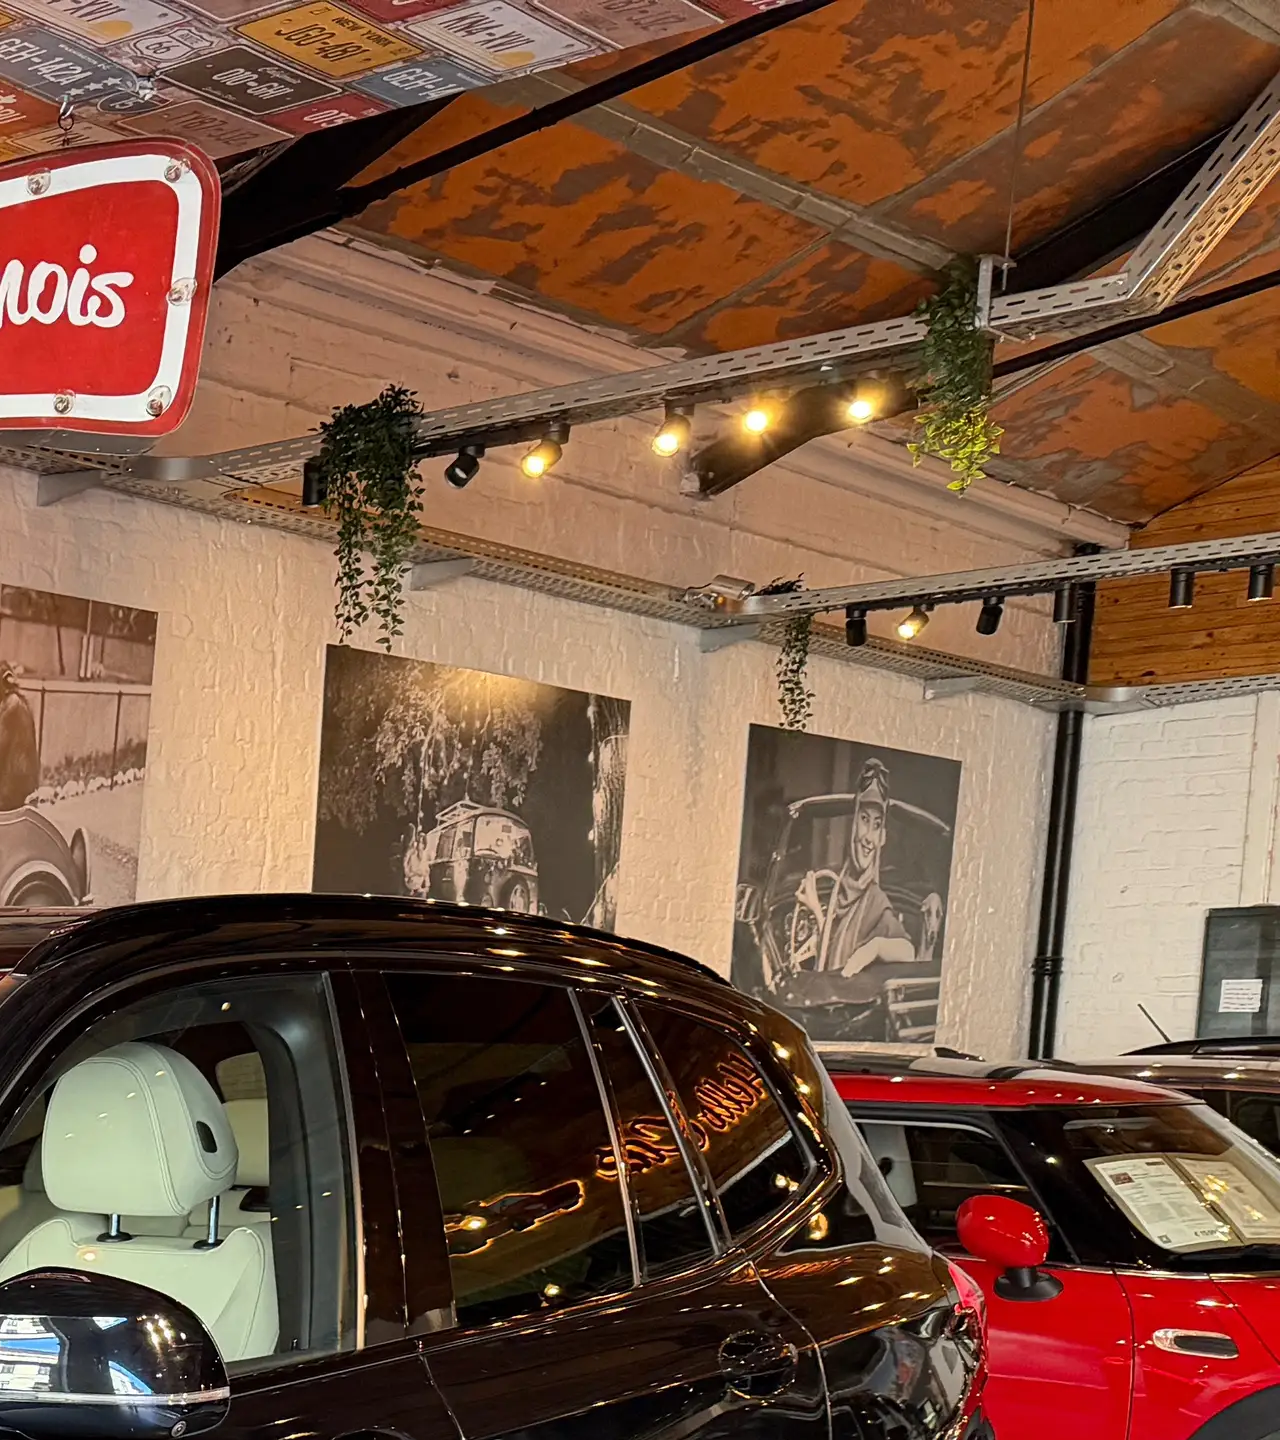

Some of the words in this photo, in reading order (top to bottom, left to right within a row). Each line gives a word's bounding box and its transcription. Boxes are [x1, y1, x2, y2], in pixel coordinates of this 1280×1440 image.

[273, 22, 372, 63] JGO-481
[332, 15, 362, 33] NEW
[453, 9, 536, 54] KN4-XV1
